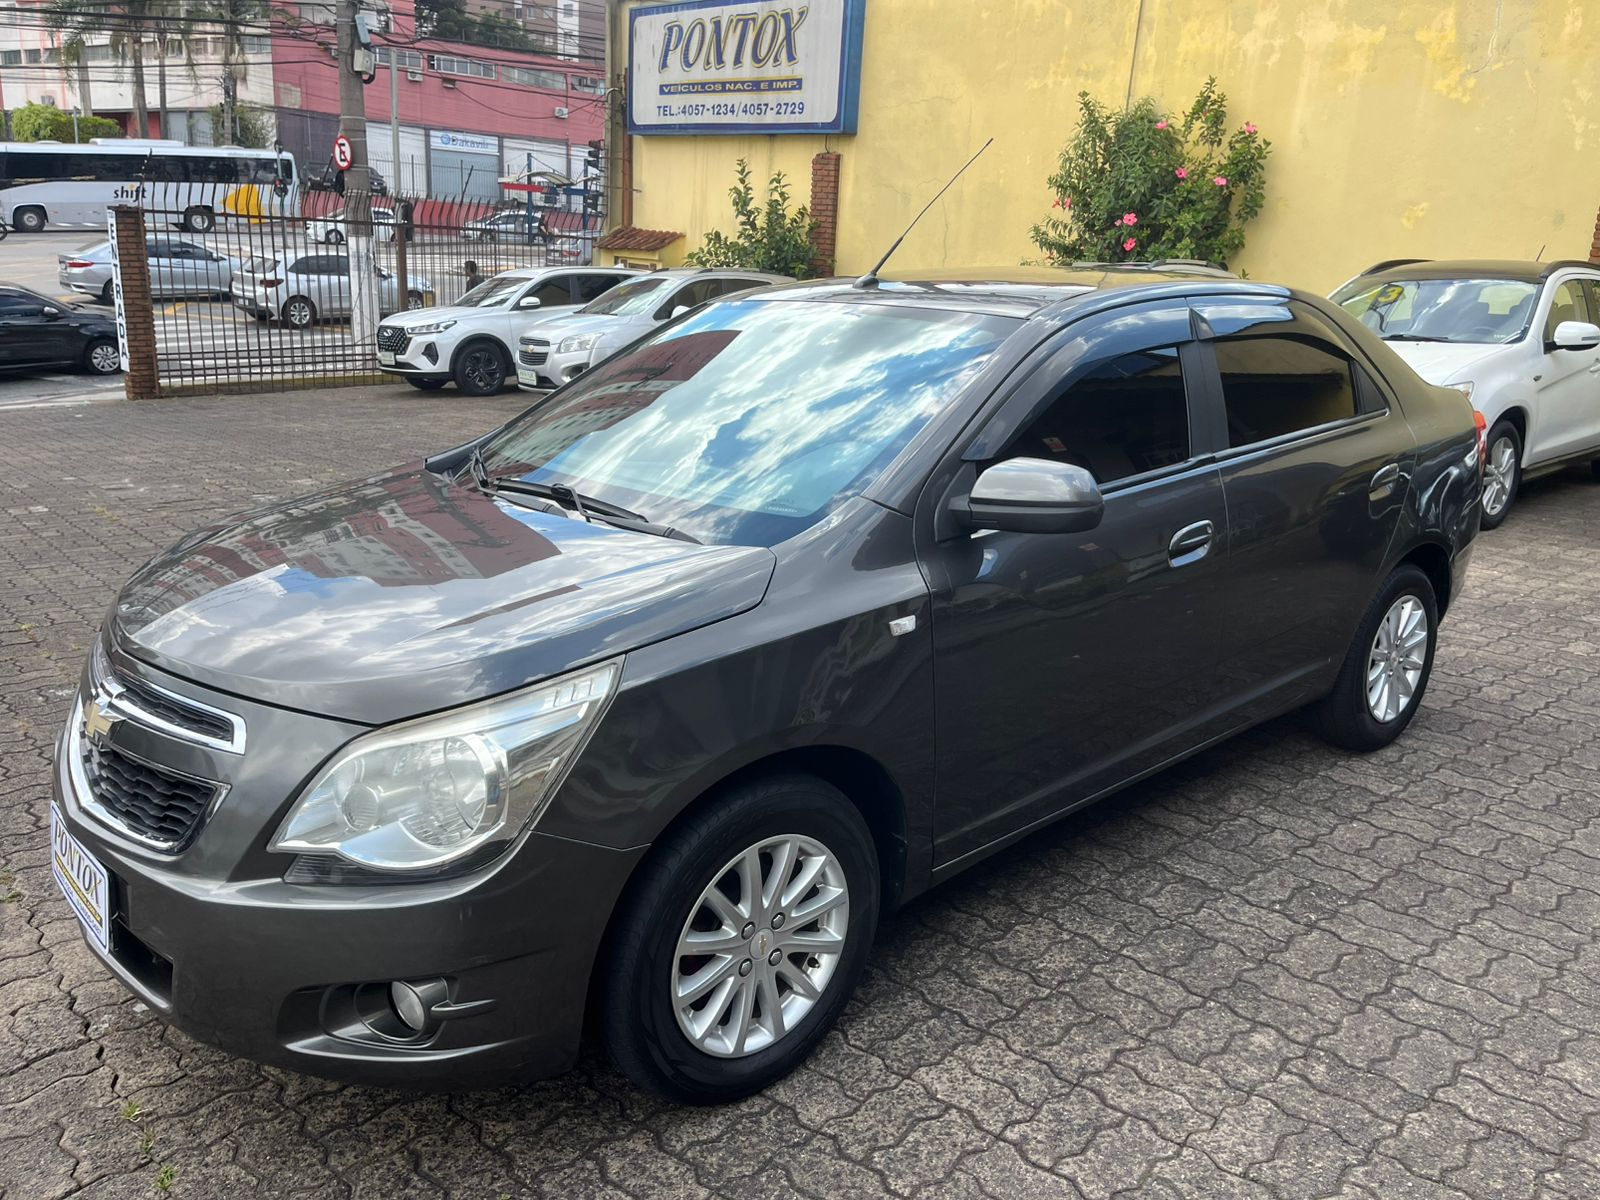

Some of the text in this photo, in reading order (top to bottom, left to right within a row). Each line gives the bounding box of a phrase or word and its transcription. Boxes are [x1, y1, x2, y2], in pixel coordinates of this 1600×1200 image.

[658, 6, 808, 73] PONTOX
[725, 82, 756, 91] NAC.
[760, 82, 769, 90] E
[772, 80, 799, 89] IMP.
[113, 185, 147, 203] shift
[109, 223, 129, 359] ENTRADA
[54, 817, 103, 906] PONTOX
